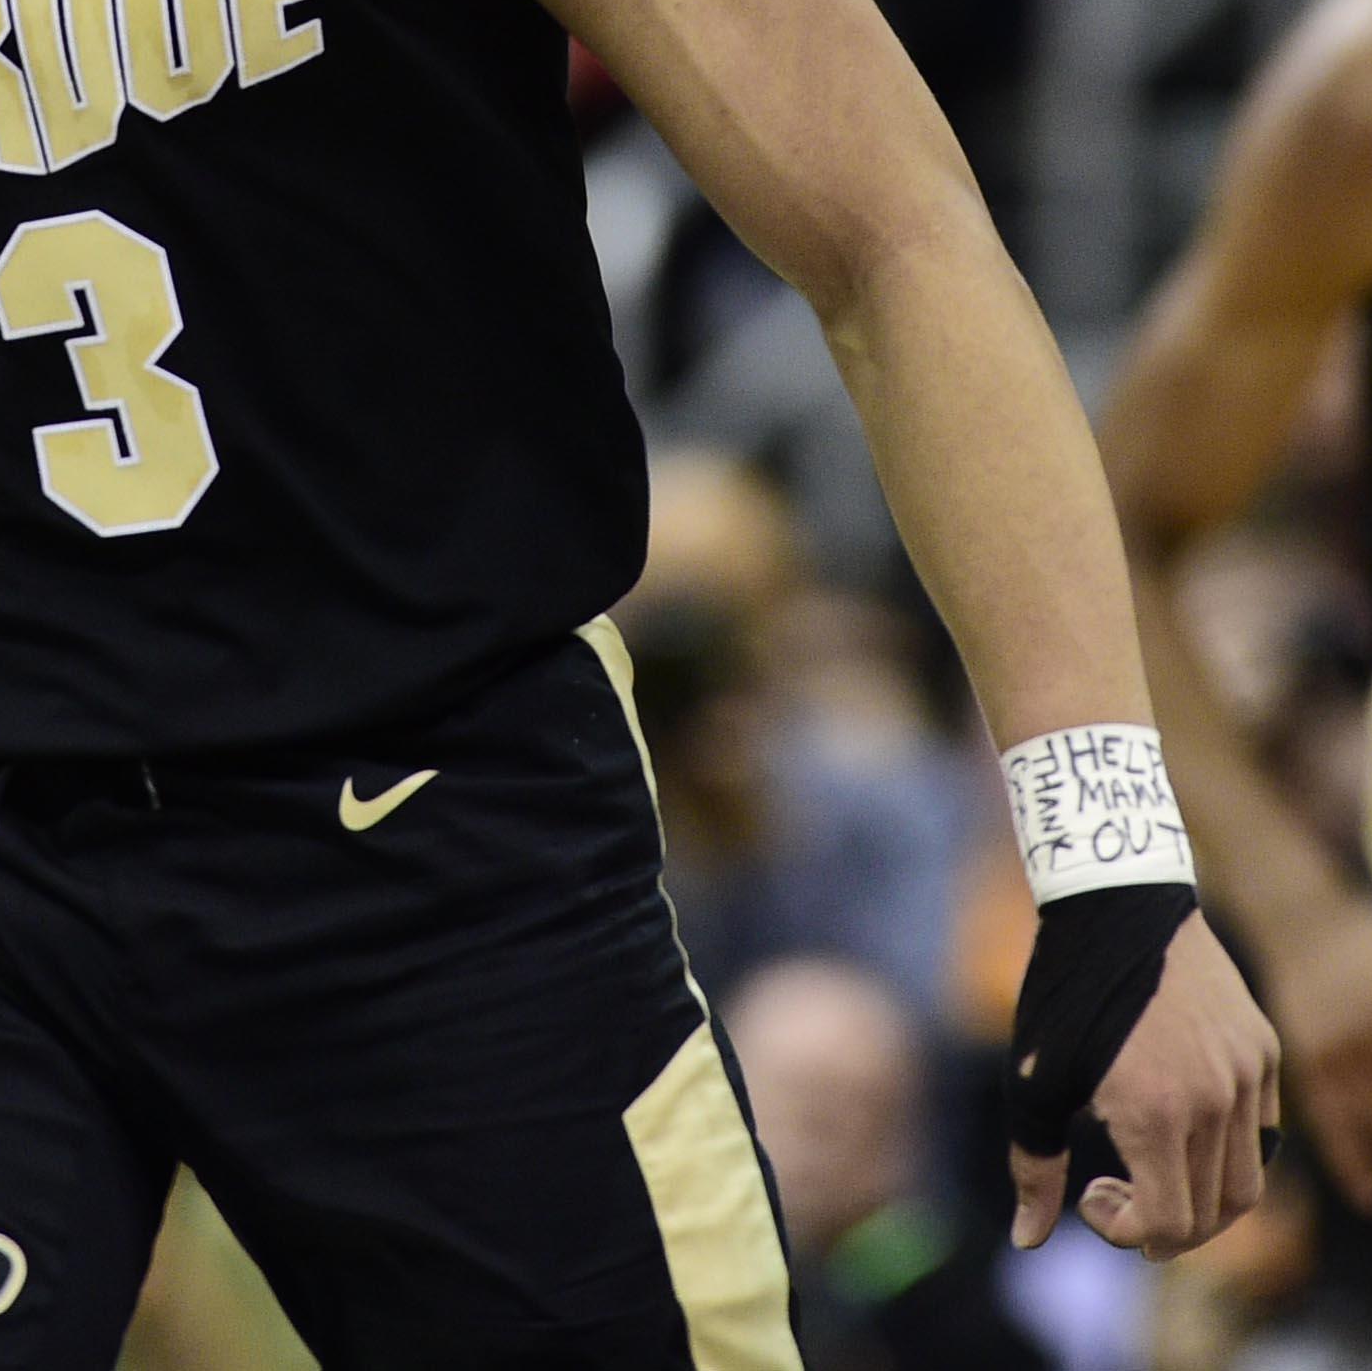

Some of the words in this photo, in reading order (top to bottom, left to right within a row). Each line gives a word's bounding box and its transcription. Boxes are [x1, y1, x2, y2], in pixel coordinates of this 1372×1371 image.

[1065, 730, 1165, 778] HELP
[1032, 738, 1073, 871] THANK
[1092, 814, 1189, 865] OUT
